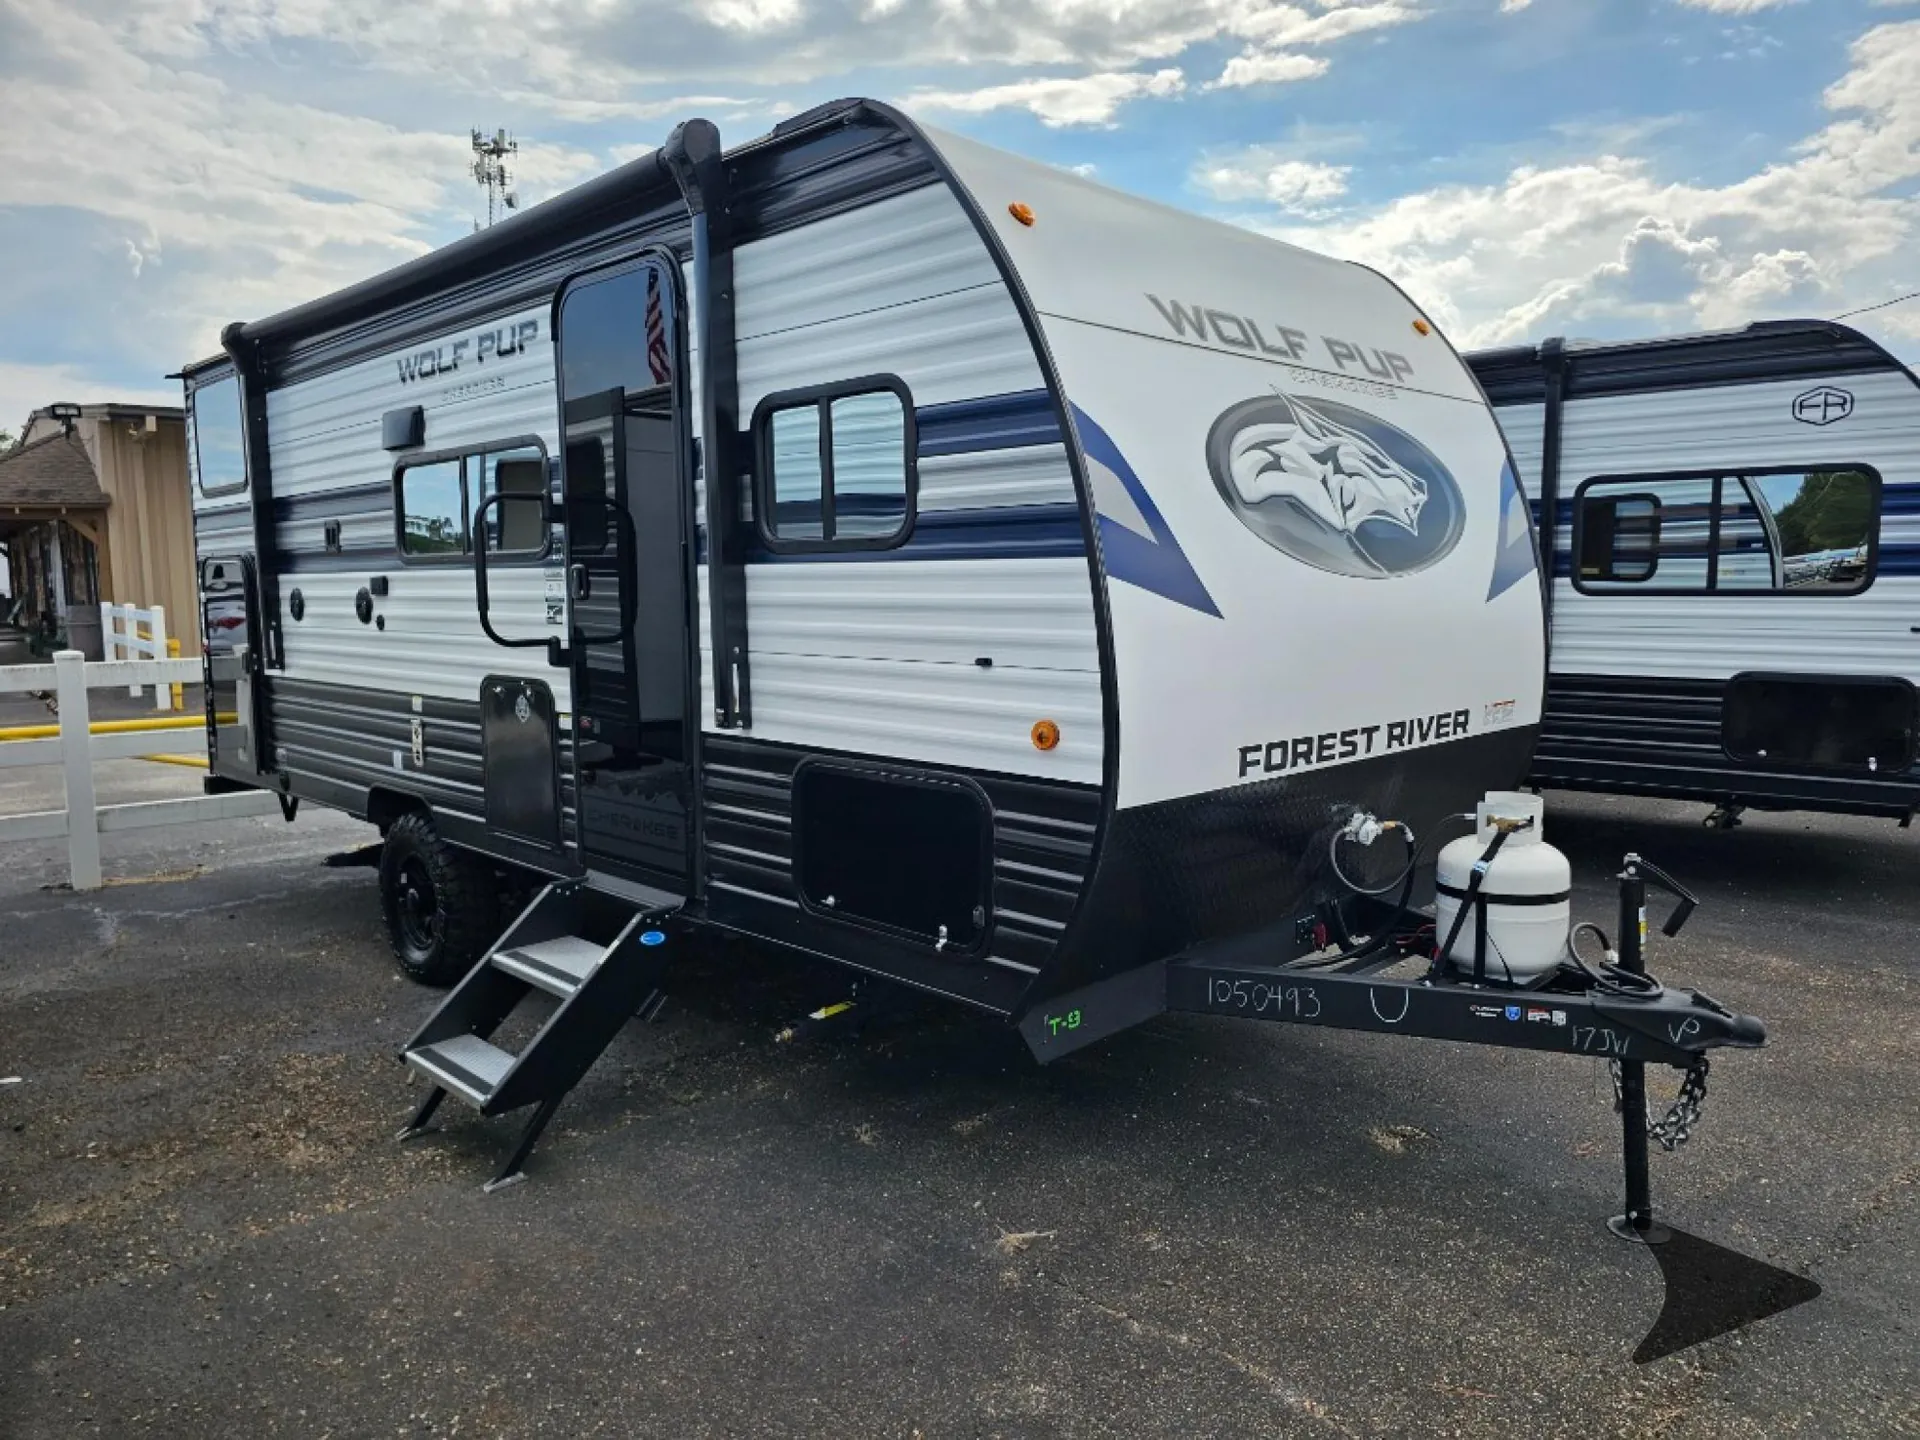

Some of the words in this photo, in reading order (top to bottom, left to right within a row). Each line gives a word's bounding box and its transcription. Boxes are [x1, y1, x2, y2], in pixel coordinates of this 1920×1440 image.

[397, 338, 469, 384] WOLF
[477, 319, 538, 363] PUP
[1144, 292, 1308, 361] WOLF
[1319, 335, 1414, 383] PUP
[1237, 725, 1381, 778] FOREST
[1386, 708, 1470, 749] RIVER
[1208, 976, 1321, 1018] 1050493
